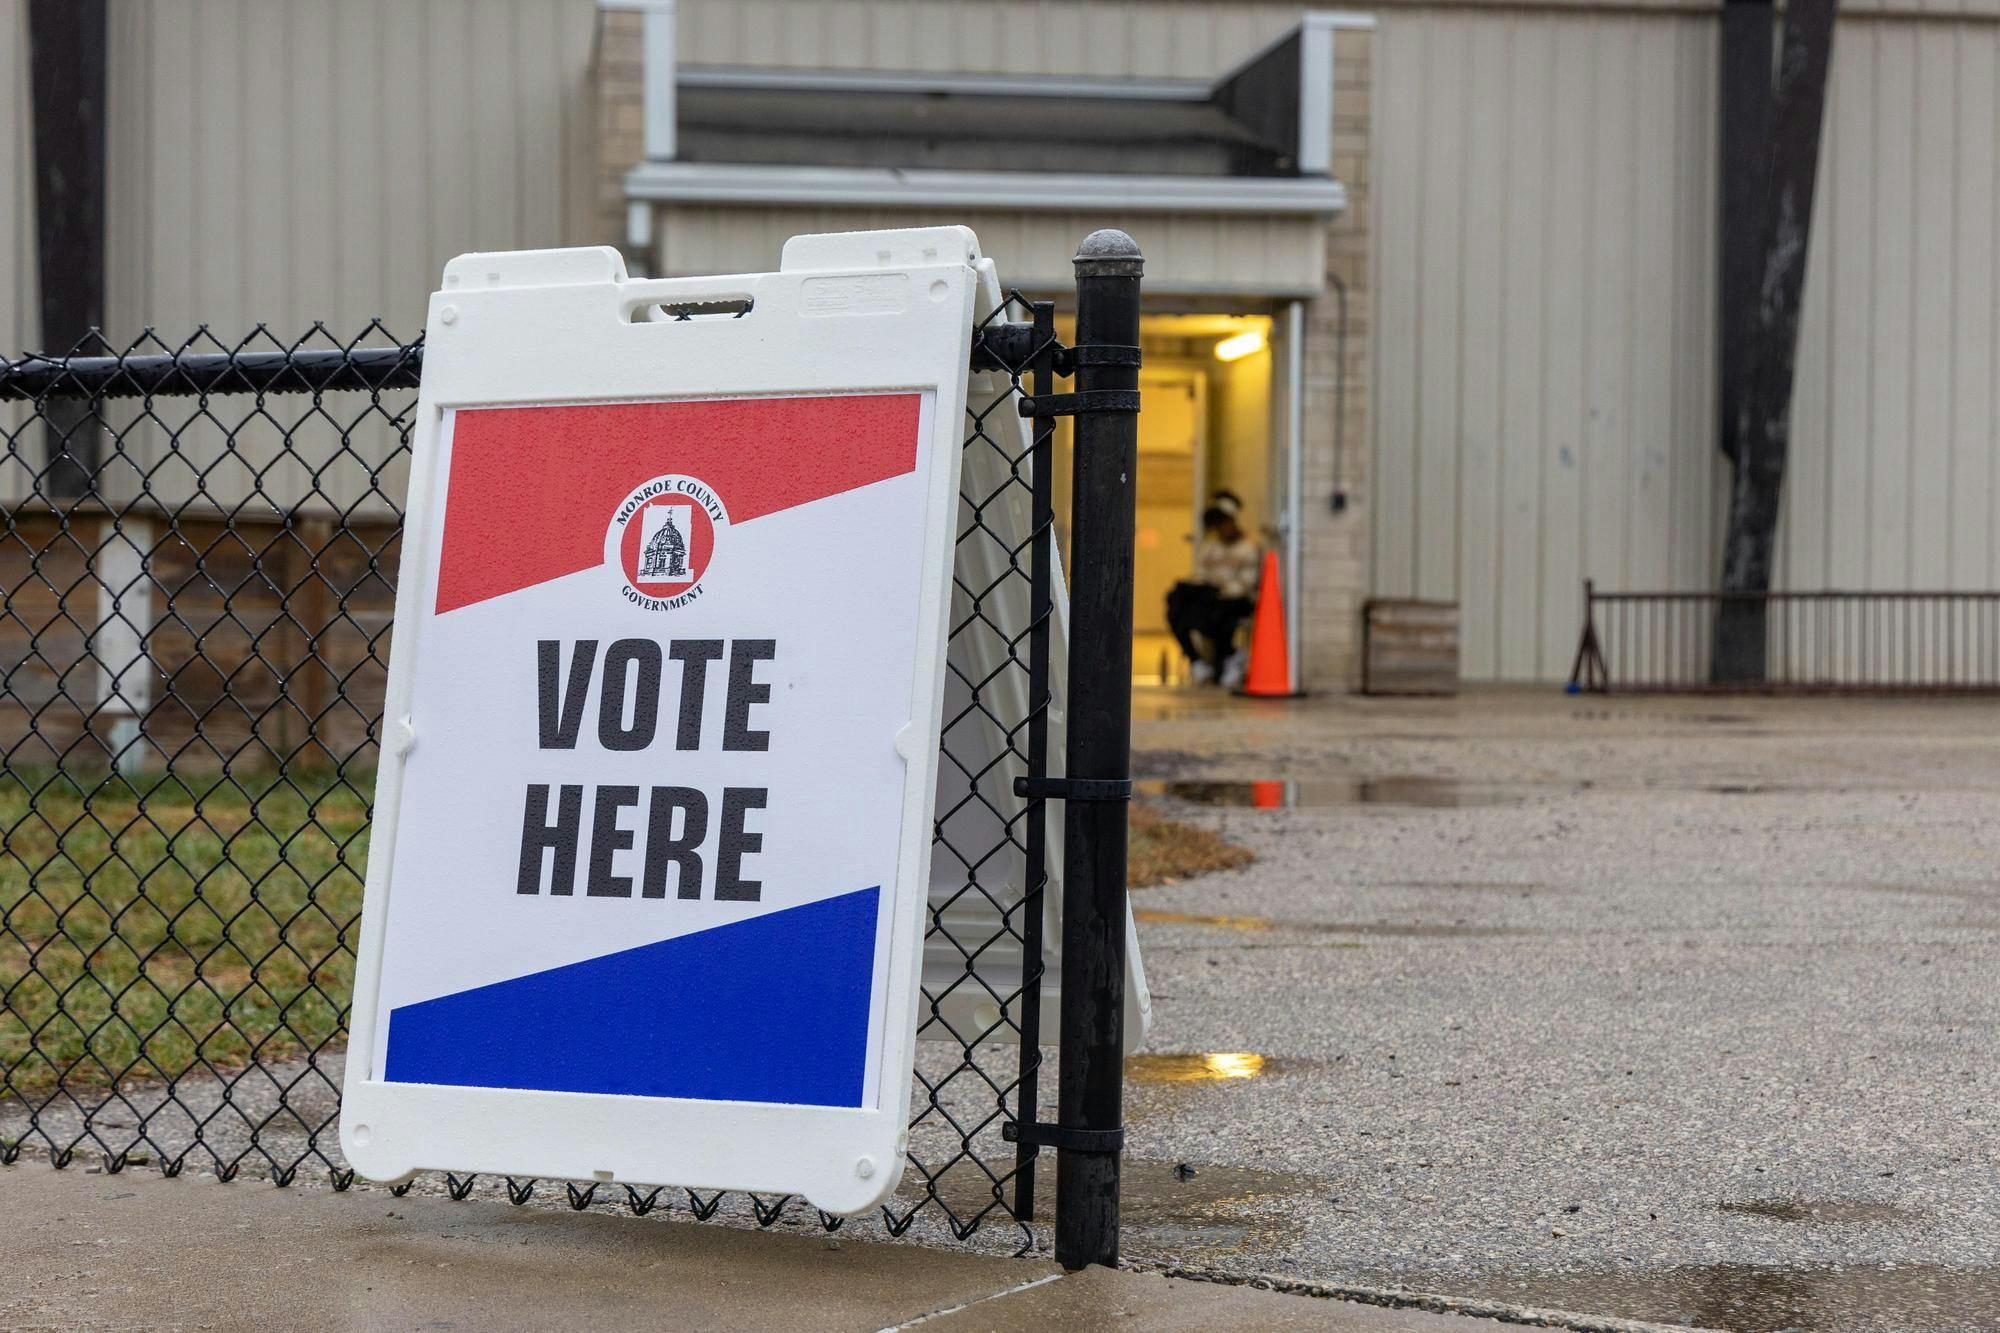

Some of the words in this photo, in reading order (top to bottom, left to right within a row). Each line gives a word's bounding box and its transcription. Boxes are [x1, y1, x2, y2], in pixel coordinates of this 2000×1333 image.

[617, 480, 672, 526] MONROE
[677, 480, 724, 522] COUNTY
[622, 583, 704, 611] GOVERNMENT
[537, 638, 777, 752] VOTE
[516, 783, 768, 902] HERE
